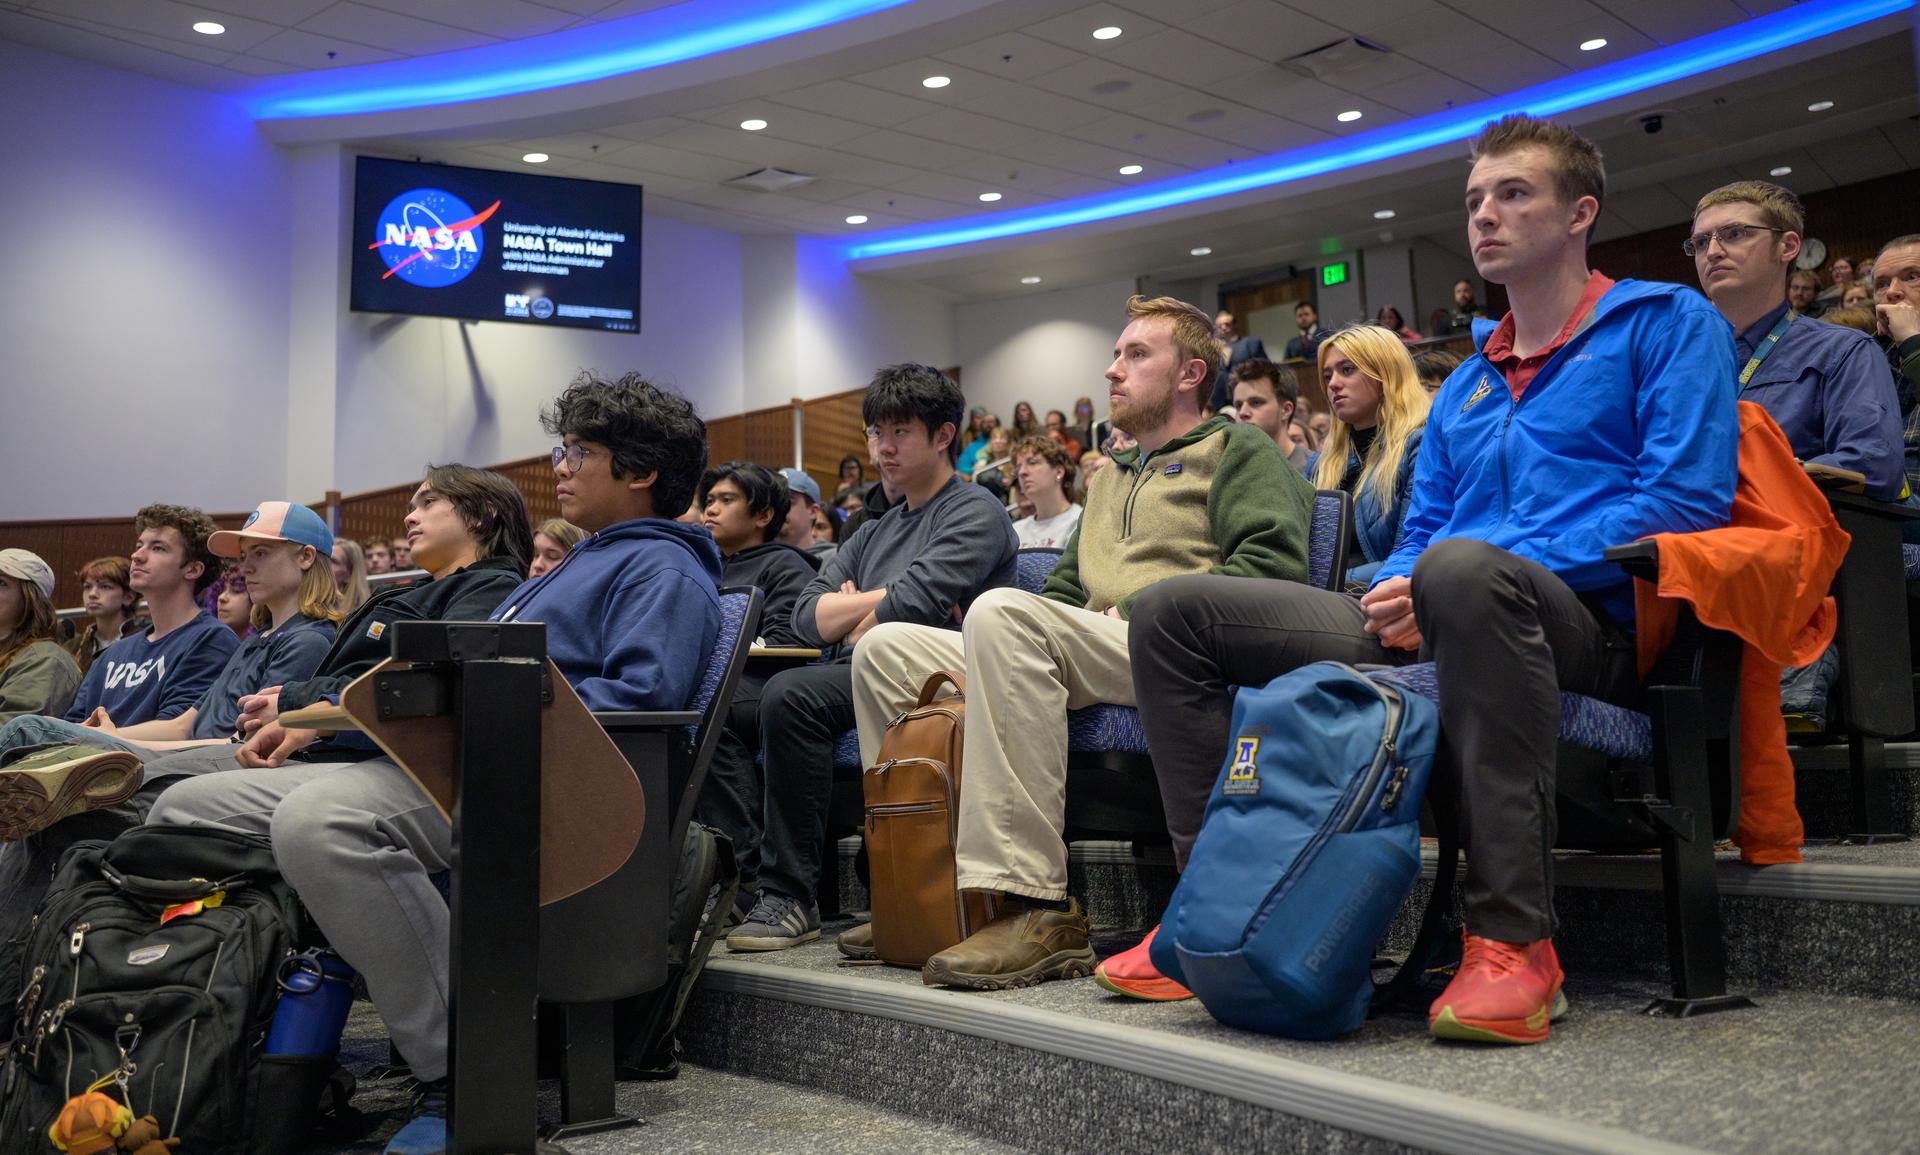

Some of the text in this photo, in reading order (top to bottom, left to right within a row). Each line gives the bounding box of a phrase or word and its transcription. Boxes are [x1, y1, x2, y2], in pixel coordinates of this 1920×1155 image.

[385, 223, 477, 253] NASA
[503, 222, 625, 243] University of Alaska Fairbanks
[503, 234, 613, 257] NASA Town Hall
[502, 250, 605, 268] with NASA Administrator
